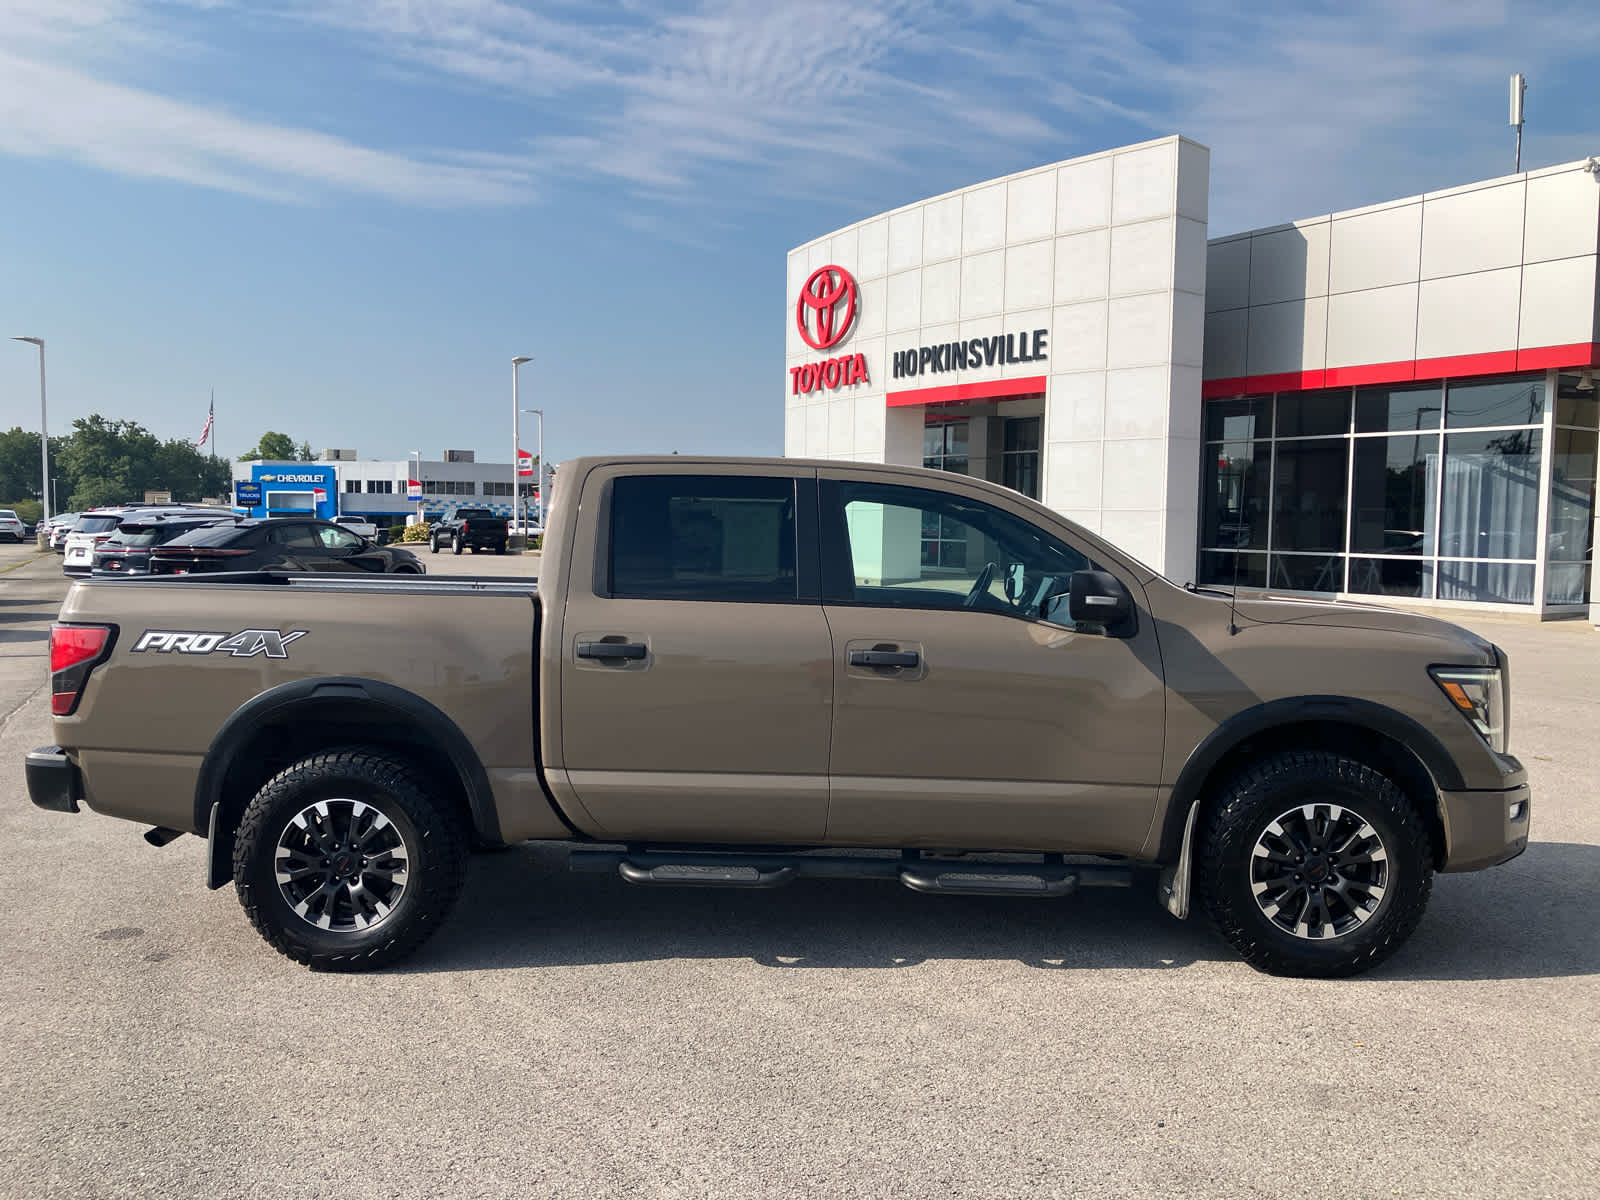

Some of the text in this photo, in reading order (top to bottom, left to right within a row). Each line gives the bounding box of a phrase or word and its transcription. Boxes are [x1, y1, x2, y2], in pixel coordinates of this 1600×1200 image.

[790, 353, 868, 394] TOYOTA
[894, 329, 1048, 379] HOPKINSVILLE
[277, 474, 324, 483] CHEVROLET
